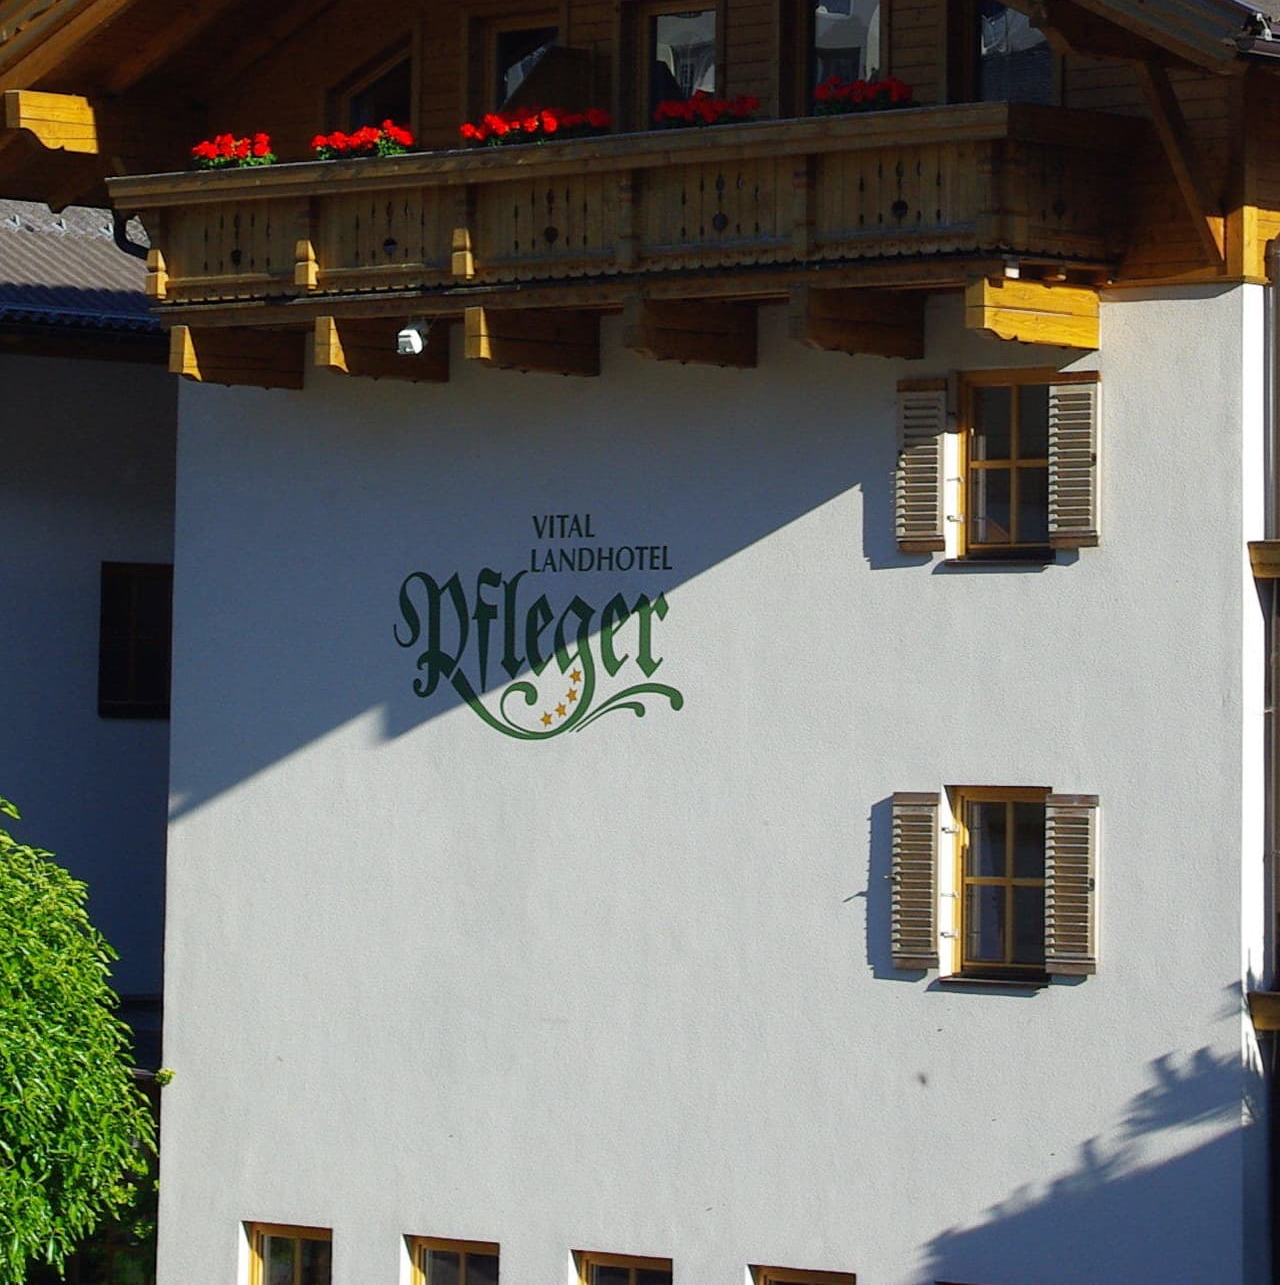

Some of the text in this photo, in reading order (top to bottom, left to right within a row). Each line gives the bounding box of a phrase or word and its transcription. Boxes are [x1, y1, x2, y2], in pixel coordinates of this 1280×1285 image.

[532, 514, 595, 539] VITAL
[530, 546, 673, 572] LANDHOTEL
[393, 567, 671, 740] Pfleger
